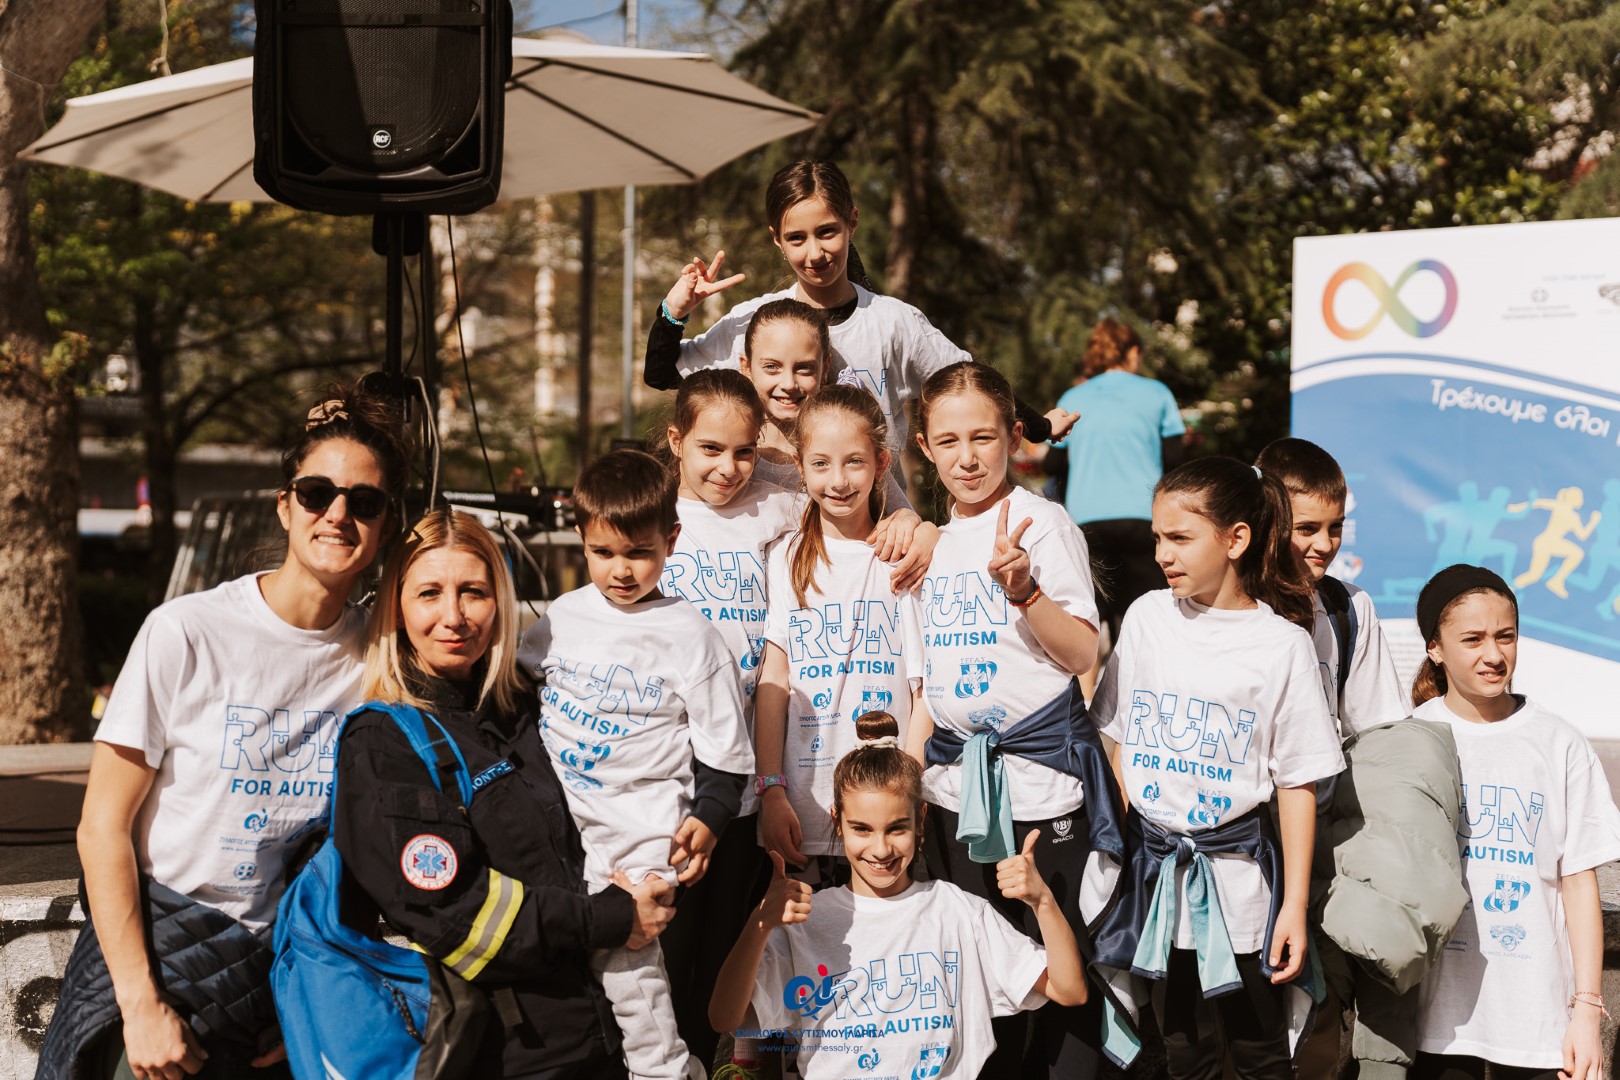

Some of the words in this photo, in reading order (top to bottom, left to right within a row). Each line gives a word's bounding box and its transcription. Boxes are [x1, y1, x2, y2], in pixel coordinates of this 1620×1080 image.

[1430, 378, 1547, 424] Τρέχουμε
[1554, 406, 1611, 438] όλοι
[718, 607, 767, 622] AUTISM
[789, 600, 903, 663] RUN
[933, 631, 997, 647] AUTISM
[799, 664, 833, 680] FOR
[836, 660, 895, 676] AUTISM
[541, 687, 559, 707] OR
[1125, 689, 1256, 765] RUN
[1132, 753, 1160, 770] FOR
[1166, 758, 1232, 782] AUTISM
[231, 778, 272, 796] FOR
[1456, 783, 1544, 848] UN
[1461, 845, 1534, 866] AUTISM
[831, 951, 959, 1020] RUN
[844, 1022, 877, 1040] FOR
[884, 1015, 955, 1035] AUTISM
